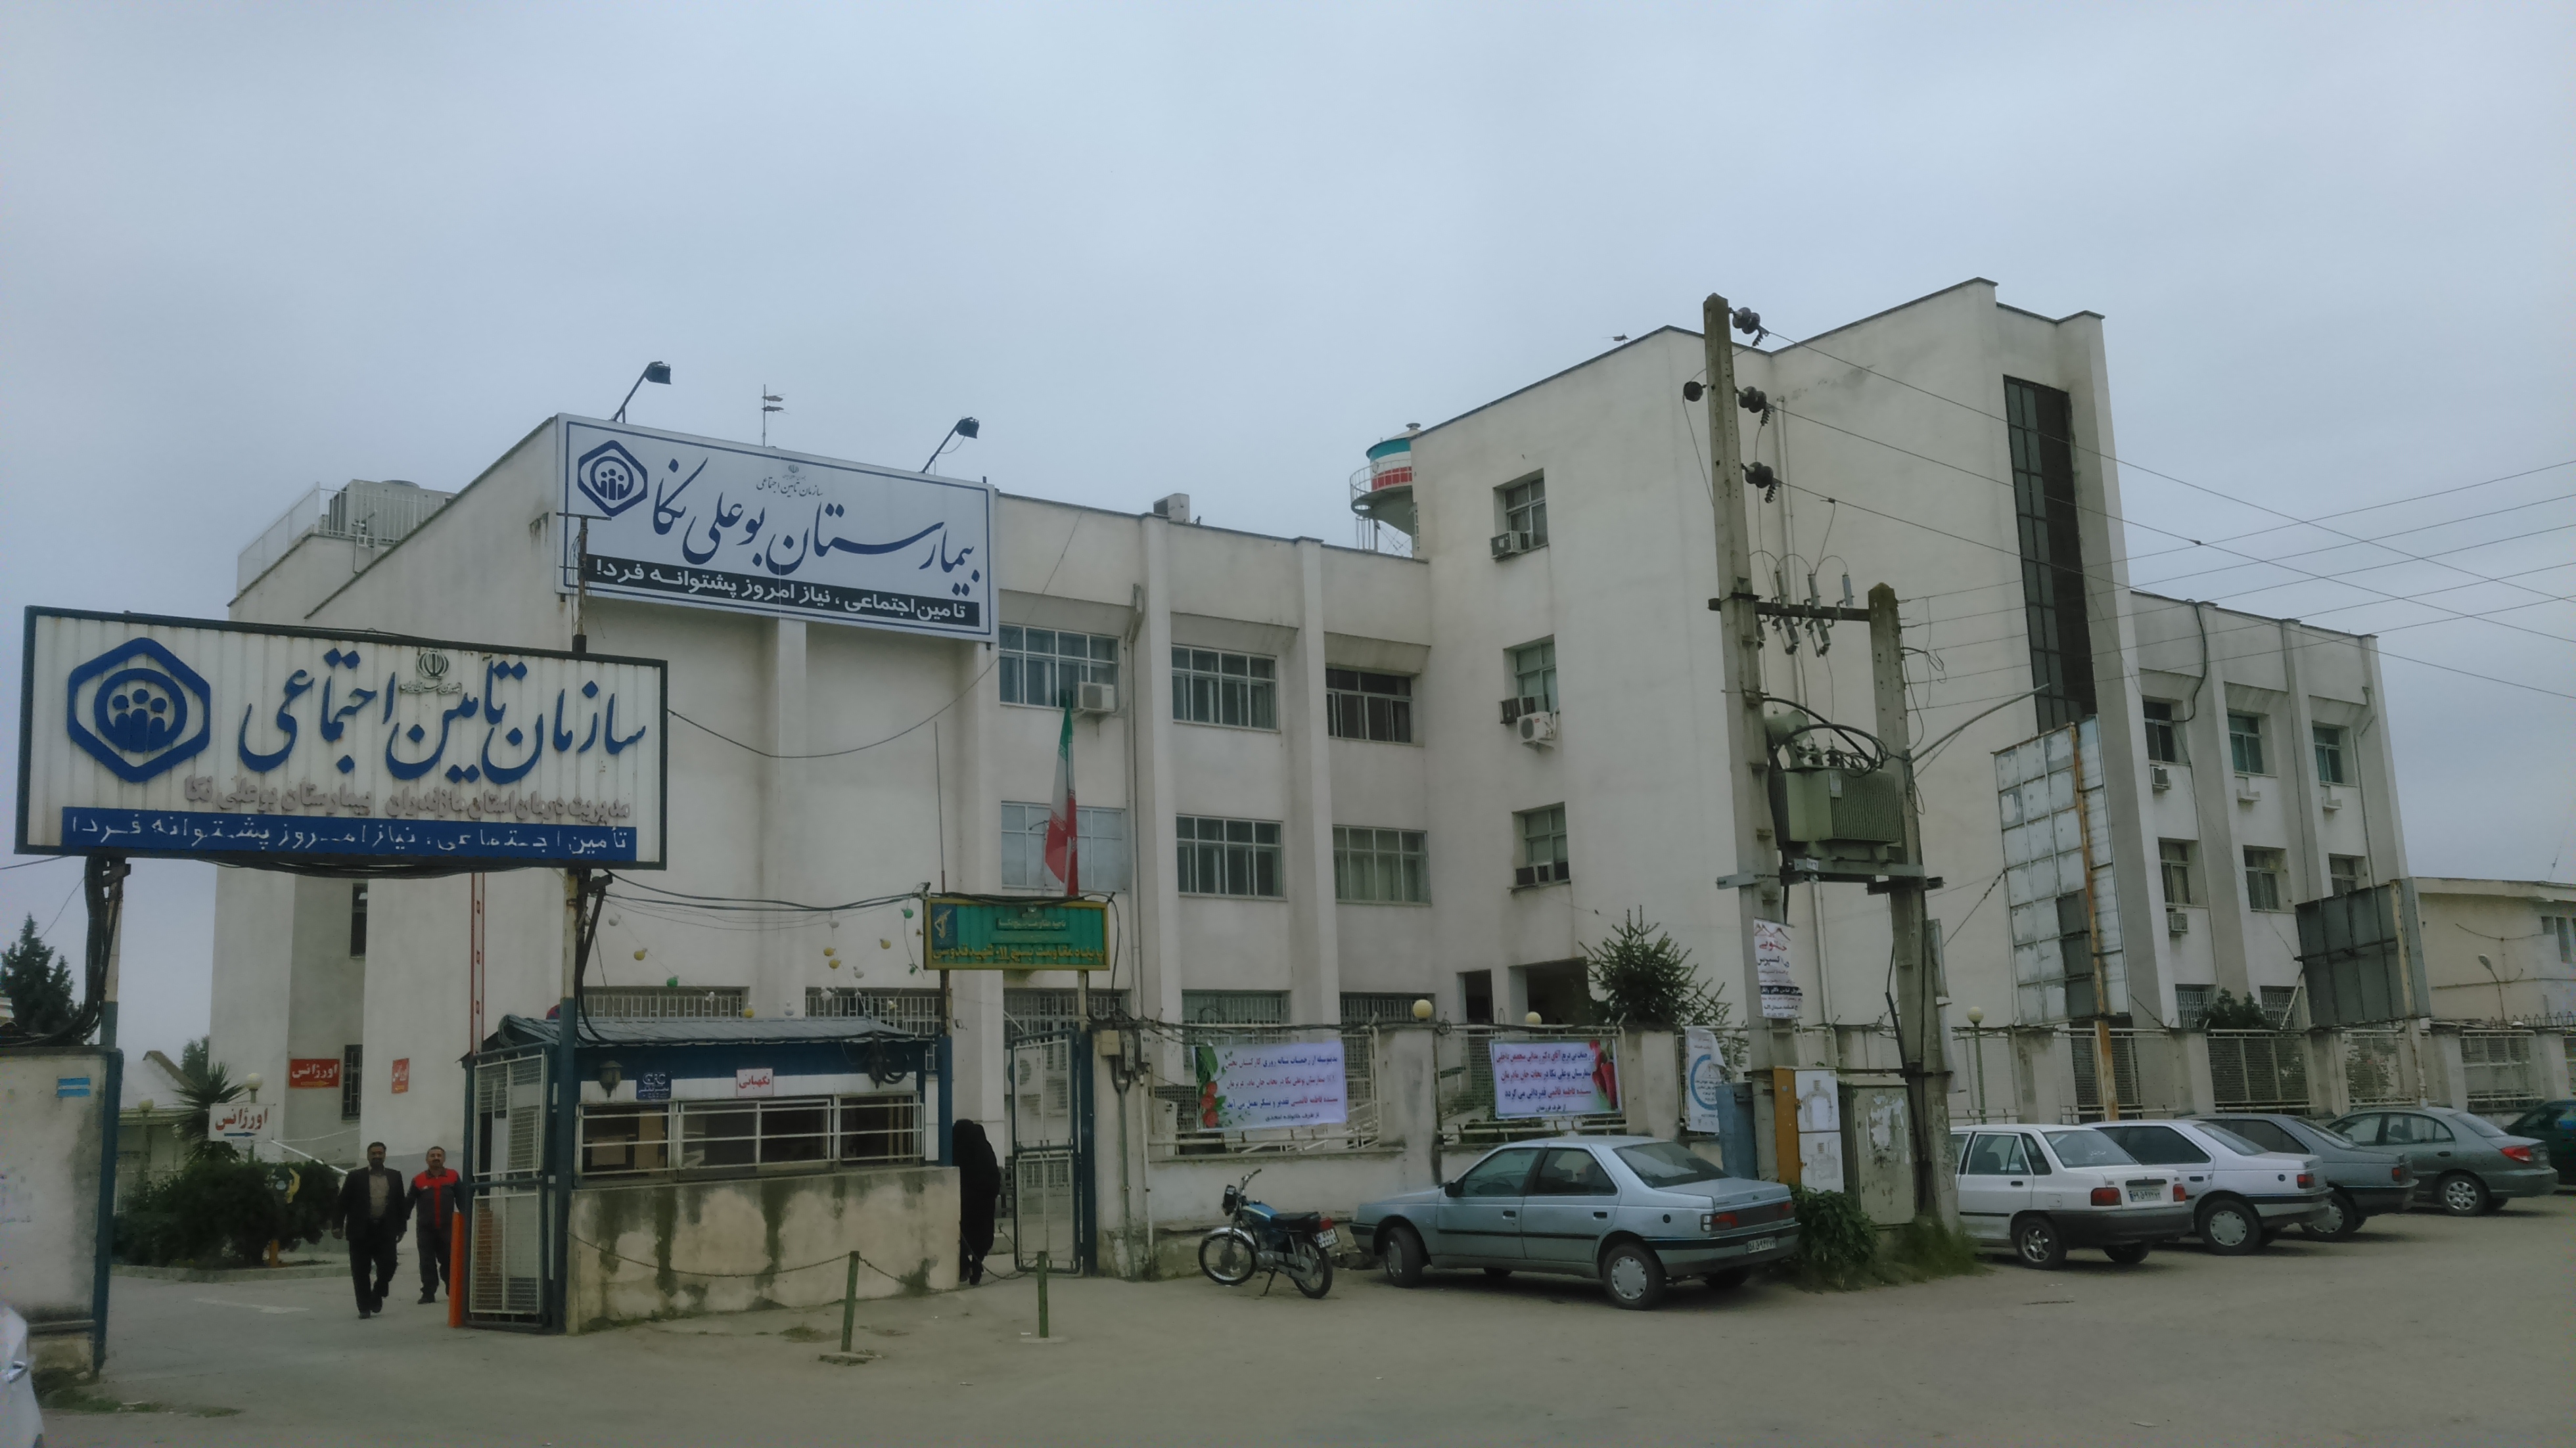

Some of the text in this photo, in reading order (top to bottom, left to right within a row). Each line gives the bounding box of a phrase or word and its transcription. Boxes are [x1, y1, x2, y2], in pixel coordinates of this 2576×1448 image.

[756, 476, 780, 493] اجتماعی
[798, 485, 823, 497] سازمان
[653, 457, 980, 597] بیمارستان بوعلی نکا
[650, 569, 737, 598] پشتوانه
[741, 579, 795, 601] امروز
[798, 586, 831, 606] نیاز
[238, 648, 397, 775] اجتماعی
[481, 680, 647, 784] سازمان
[184, 775, 630, 825] مدیریت درمان استان مازندران بیمارستان بوعلی نکا
[73, 813, 142, 843] فردا
[152, 816, 268, 849] پشتوانه
[278, 823, 366, 848] امروز
[373, 825, 415, 849] نیاز
[1011, 948, 1033, 962] بسیج
[1035, 945, 1073, 960] مقاومت
[292, 1063, 338, 1079] اورژانس
[739, 1072, 771, 1089] نگهبانی
[215, 1107, 268, 1131] اورژانس
